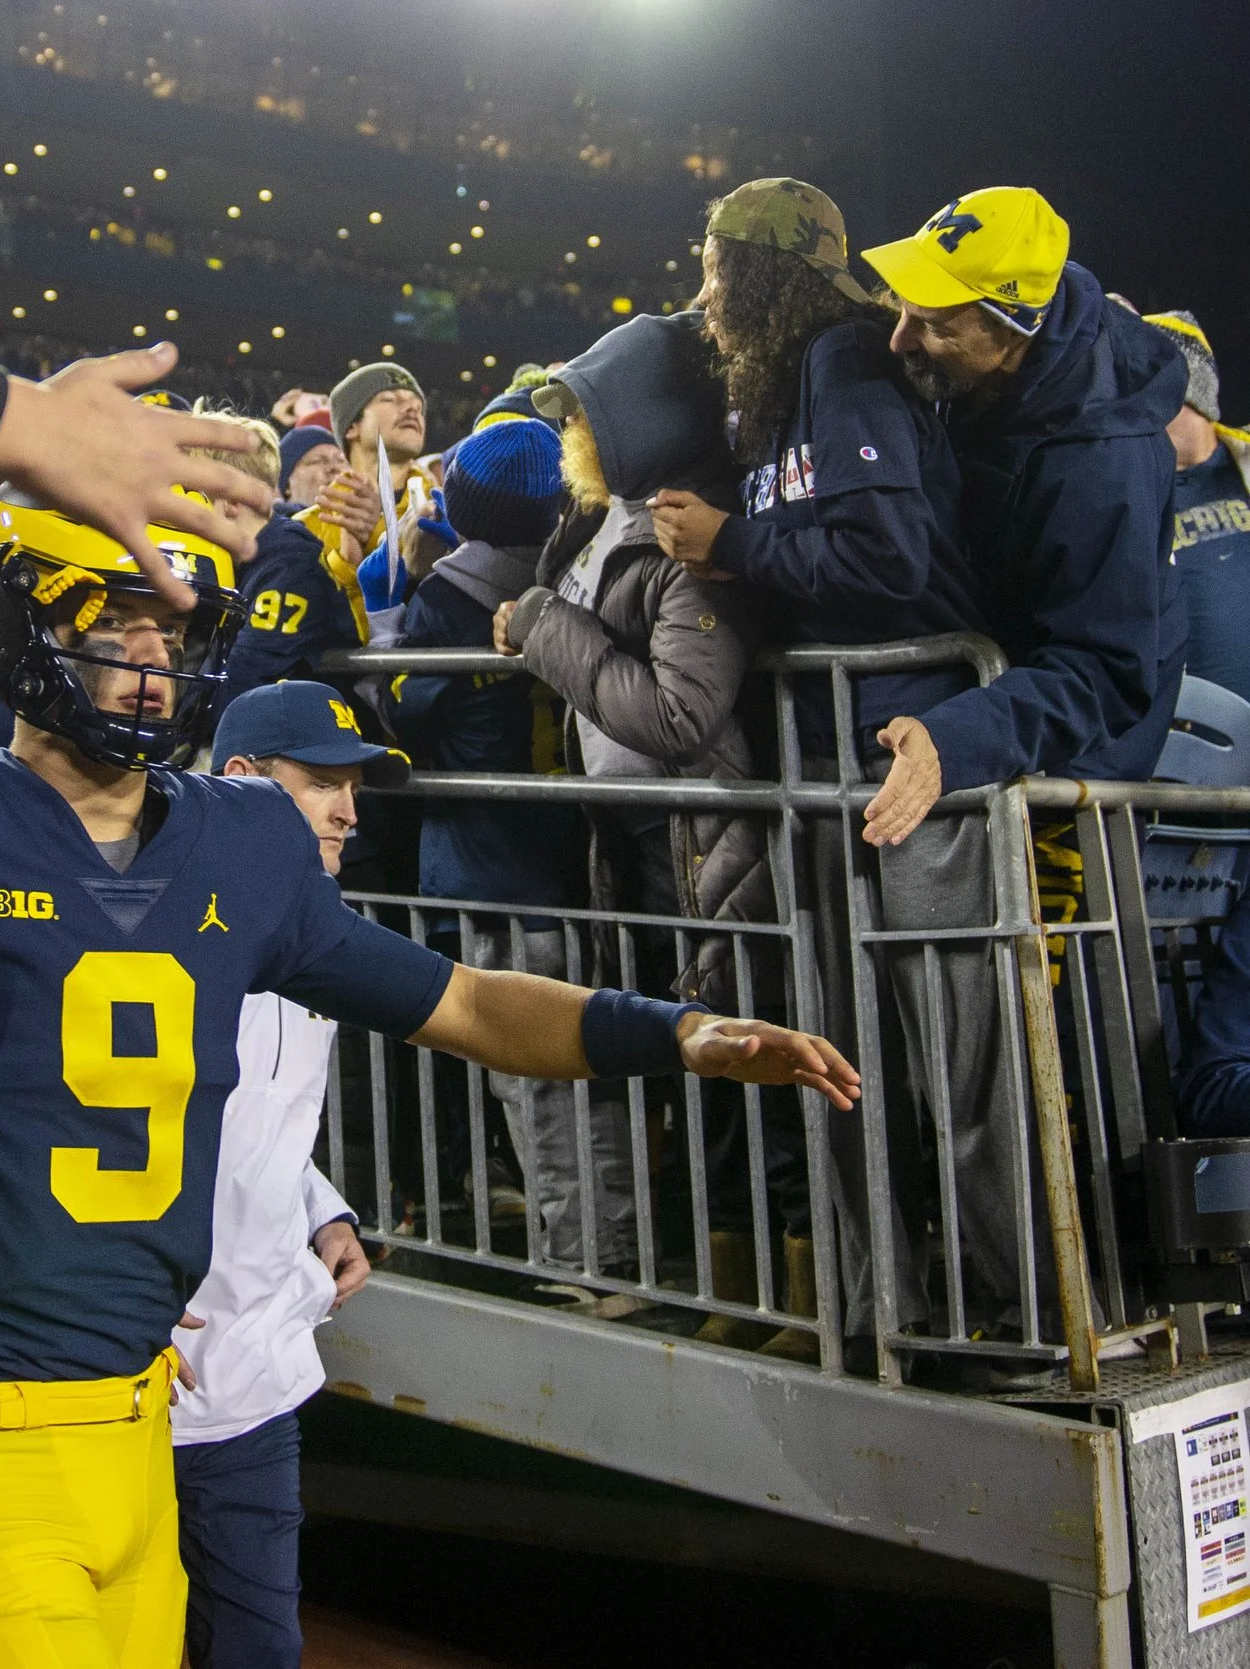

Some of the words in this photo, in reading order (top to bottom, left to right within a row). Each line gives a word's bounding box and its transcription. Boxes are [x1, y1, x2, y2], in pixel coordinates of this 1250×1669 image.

[250, 590, 308, 634] 97
[328, 699, 362, 736] M
[50, 951, 195, 1223] 9
